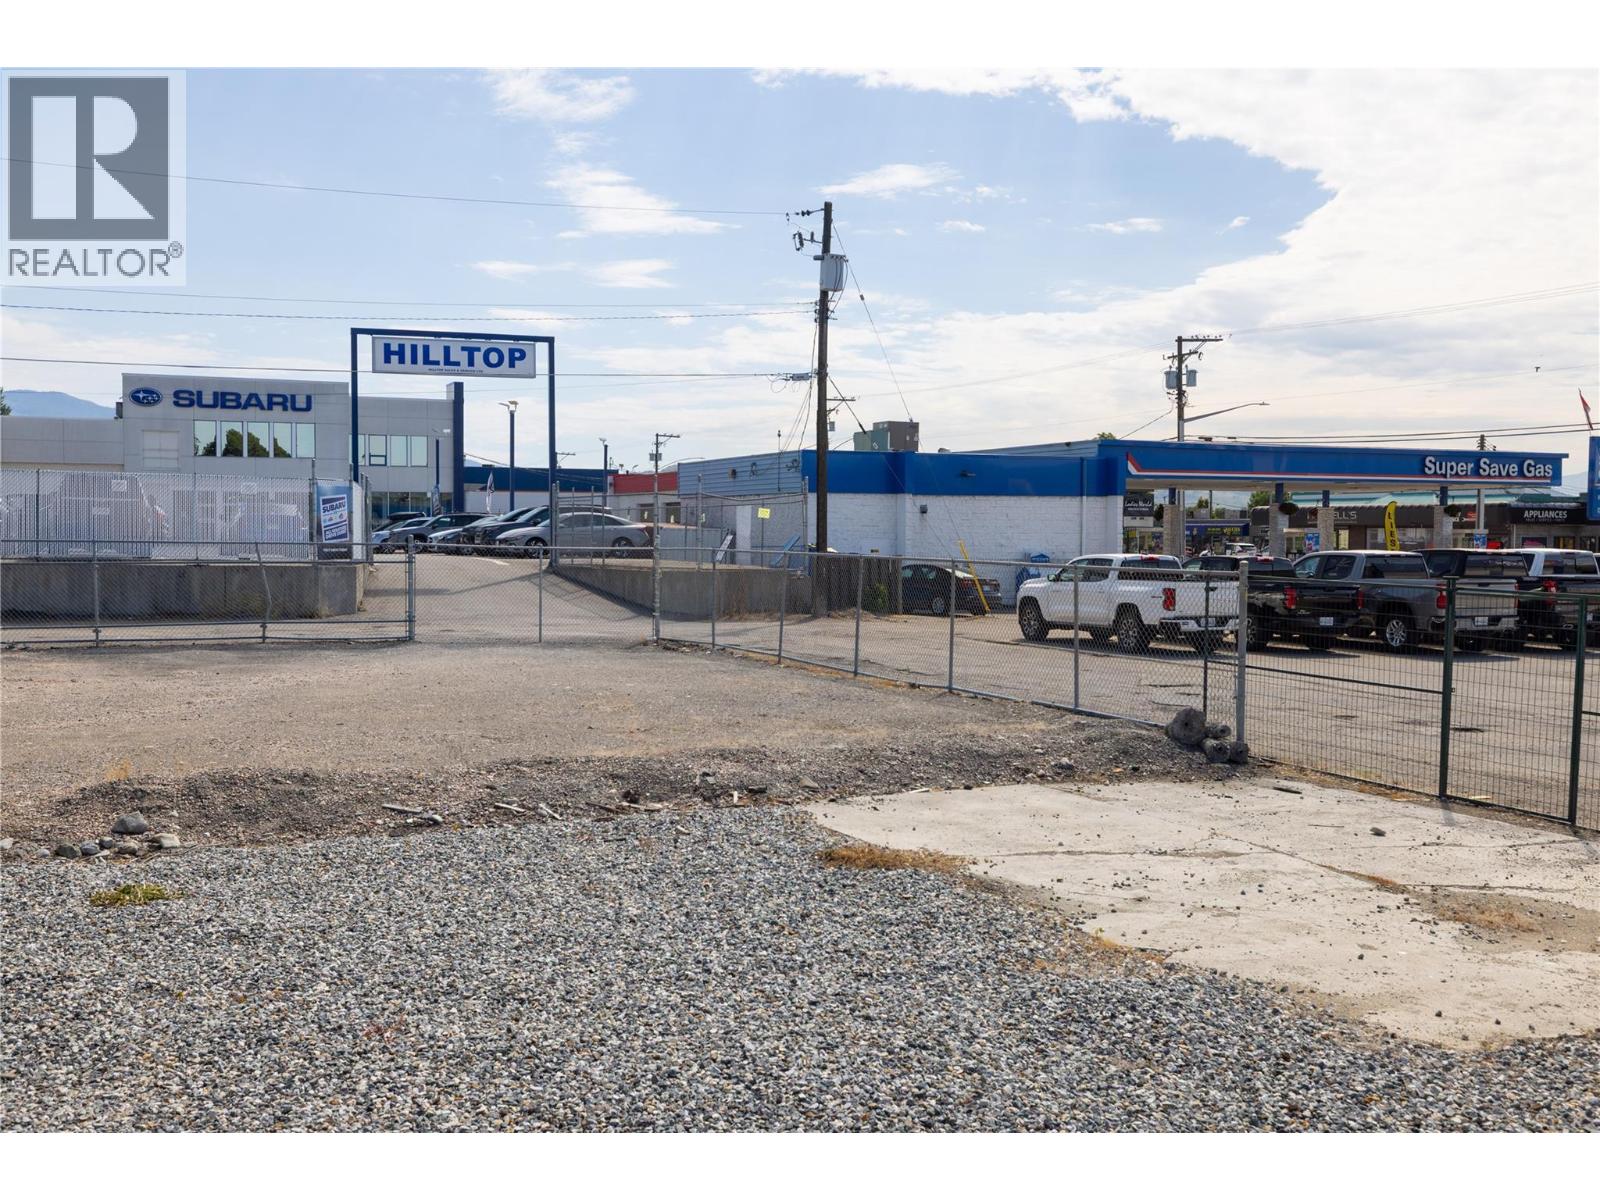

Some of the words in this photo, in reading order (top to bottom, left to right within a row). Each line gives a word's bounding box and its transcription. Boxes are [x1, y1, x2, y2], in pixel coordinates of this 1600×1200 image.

[383, 343, 527, 369] HILLTOP
[172, 389, 313, 413] SUBARU
[1424, 456, 1474, 478] Super
[1479, 457, 1518, 477] Save
[1523, 459, 1553, 477] Gas
[322, 500, 346, 514] SUBARU
[1523, 510, 1568, 519] APPLIANCES
